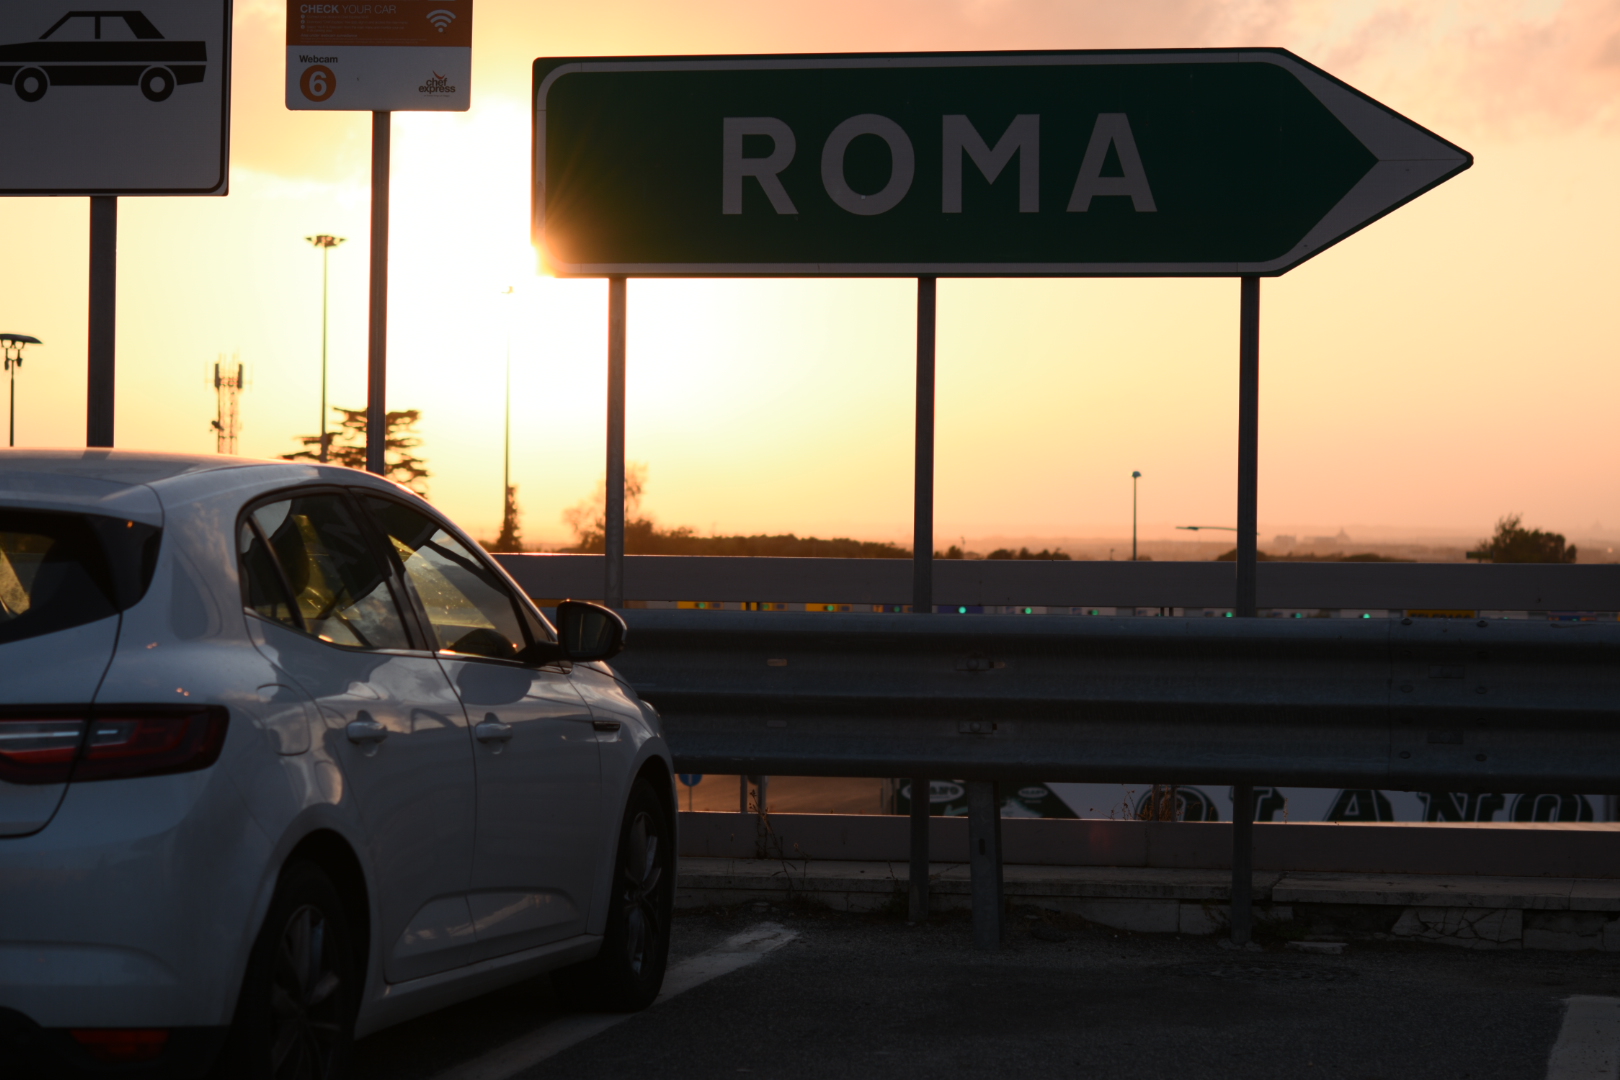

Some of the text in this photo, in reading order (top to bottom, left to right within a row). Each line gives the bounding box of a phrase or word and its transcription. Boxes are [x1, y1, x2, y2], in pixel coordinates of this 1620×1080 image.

[300, 4, 397, 14] CHECK YOUR CAR
[299, 55, 339, 64] Webcam
[308, 70, 328, 97] 6
[426, 77, 448, 86] chef
[418, 85, 456, 94] express
[722, 113, 1158, 216] ROMA
